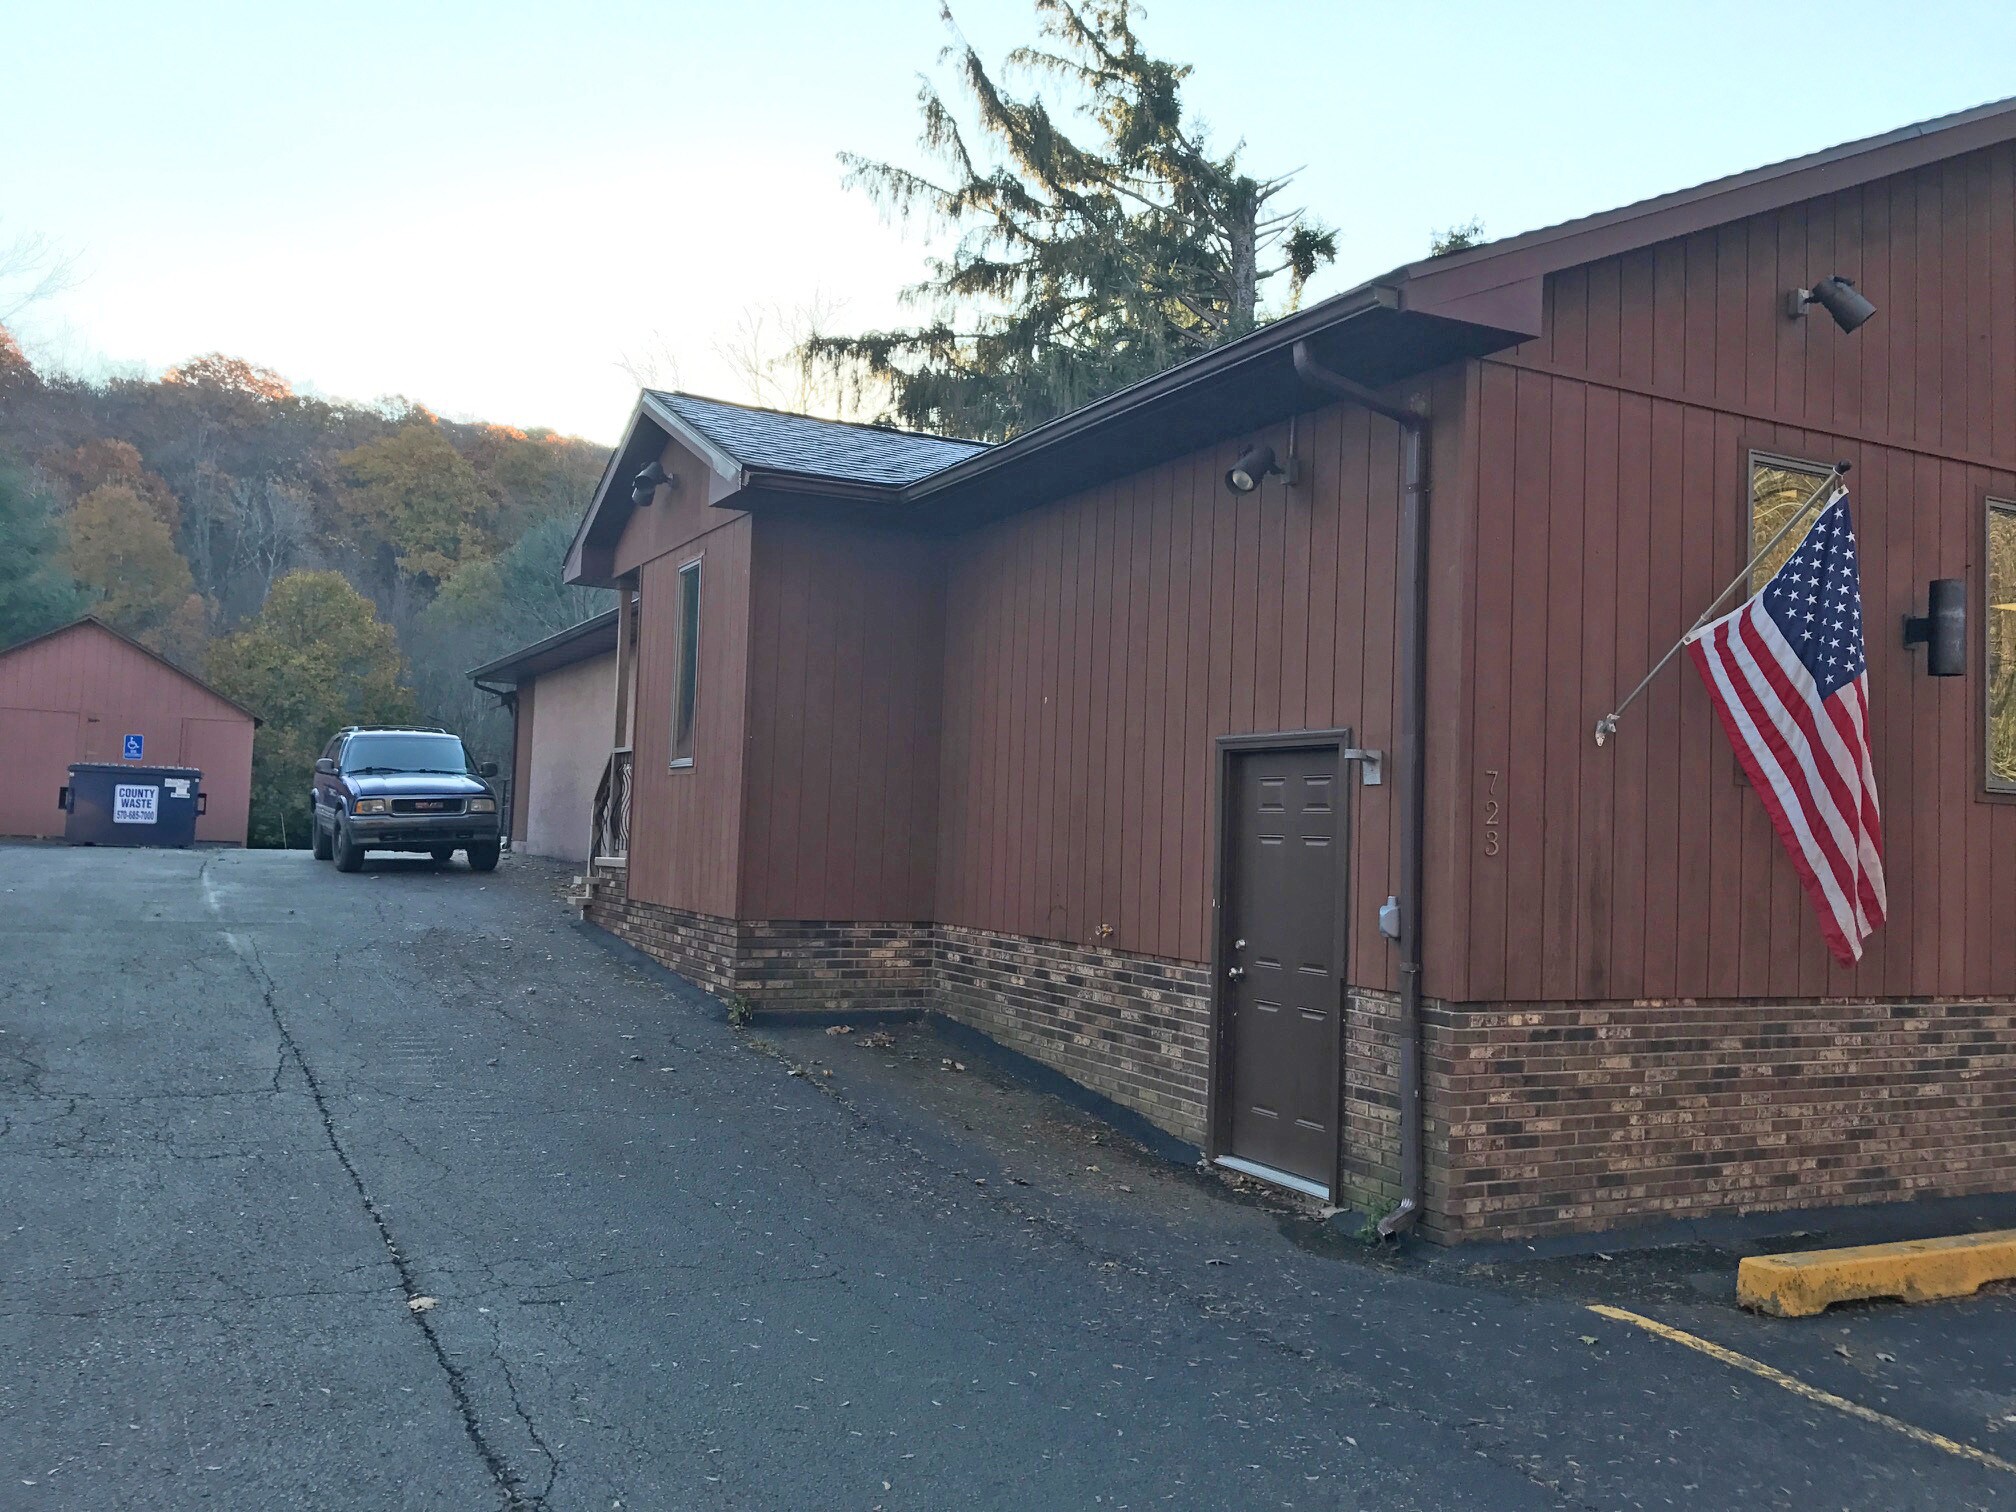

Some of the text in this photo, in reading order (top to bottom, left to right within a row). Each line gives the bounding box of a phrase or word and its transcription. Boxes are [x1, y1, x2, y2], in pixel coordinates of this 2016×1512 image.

[119, 788, 155, 798] COUNTY
[121, 798, 152, 809] WASTE
[1485, 770, 1499, 856] 723
